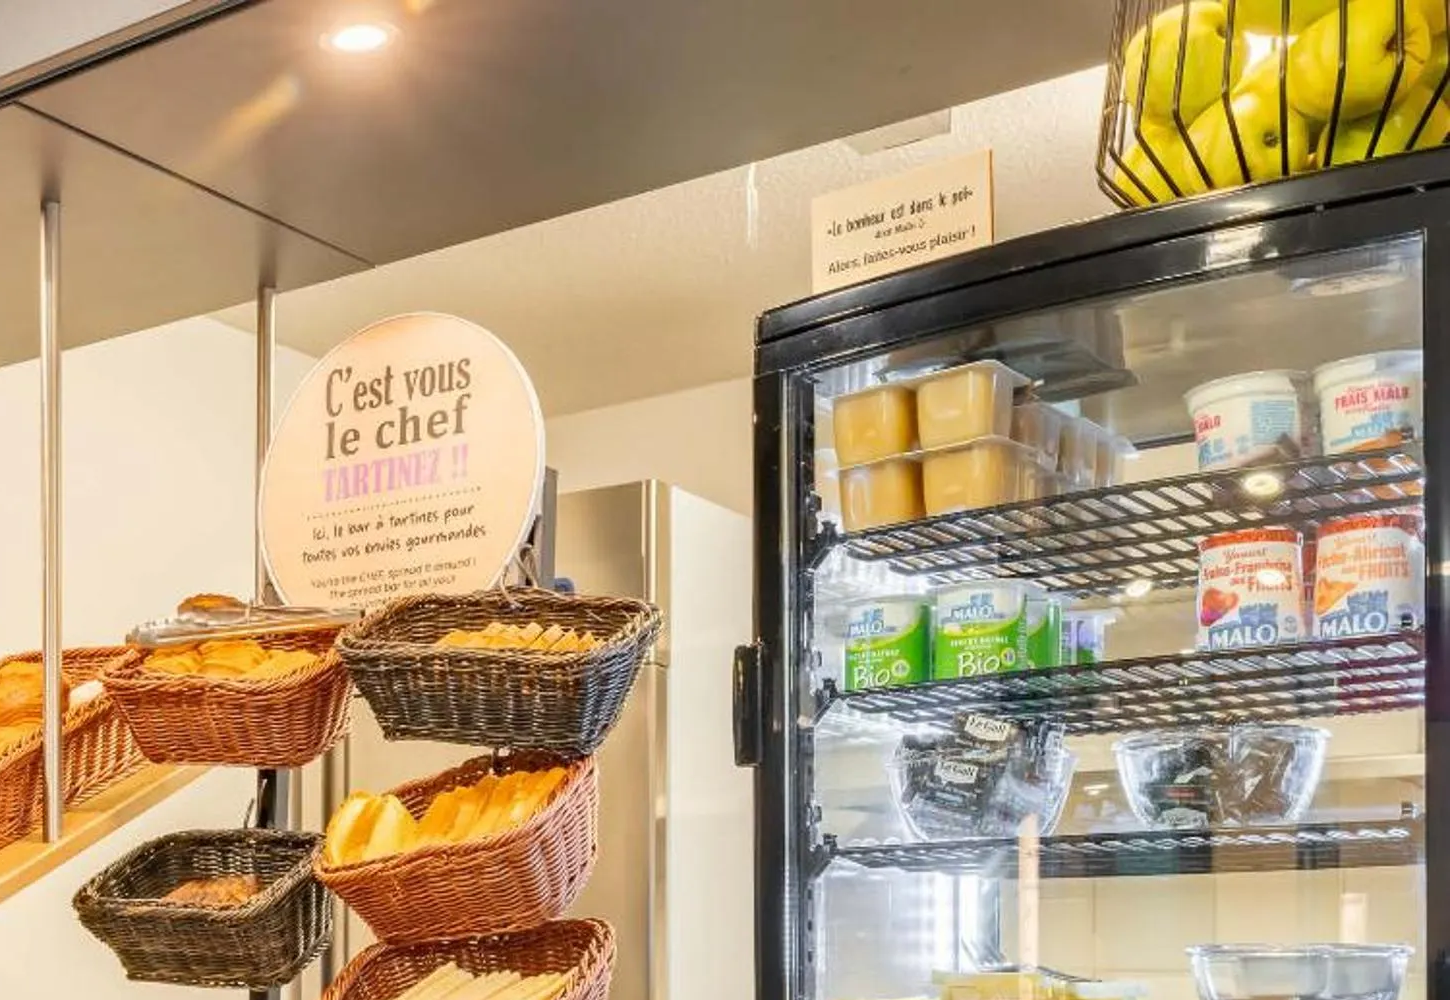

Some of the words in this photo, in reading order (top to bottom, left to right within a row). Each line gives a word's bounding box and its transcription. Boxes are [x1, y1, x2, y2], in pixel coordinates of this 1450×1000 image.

[846, 212, 885, 235] bonheur
[890, 203, 905, 220] est
[910, 198, 933, 216] dans
[938, 192, 947, 207] le
[325, 365, 394, 418] C'est
[404, 357, 472, 402] vous
[325, 421, 361, 460] le
[375, 393, 472, 450] chef
[322, 449, 442, 503] TARTINEZ
[451, 443, 469, 480] !!
[348, 521, 371, 536] bar
[389, 509, 439, 528] tartines
[444, 504, 476, 526] pour
[302, 548, 338, 565] toutes
[341, 543, 361, 559] vos
[365, 536, 401, 556] envies
[405, 523, 488, 552] gourmandes
[1211, 624, 1277, 650] MALO
[1321, 612, 1386, 638] MALO
[854, 665, 891, 689] Bio
[958, 651, 1000, 678] Bio
